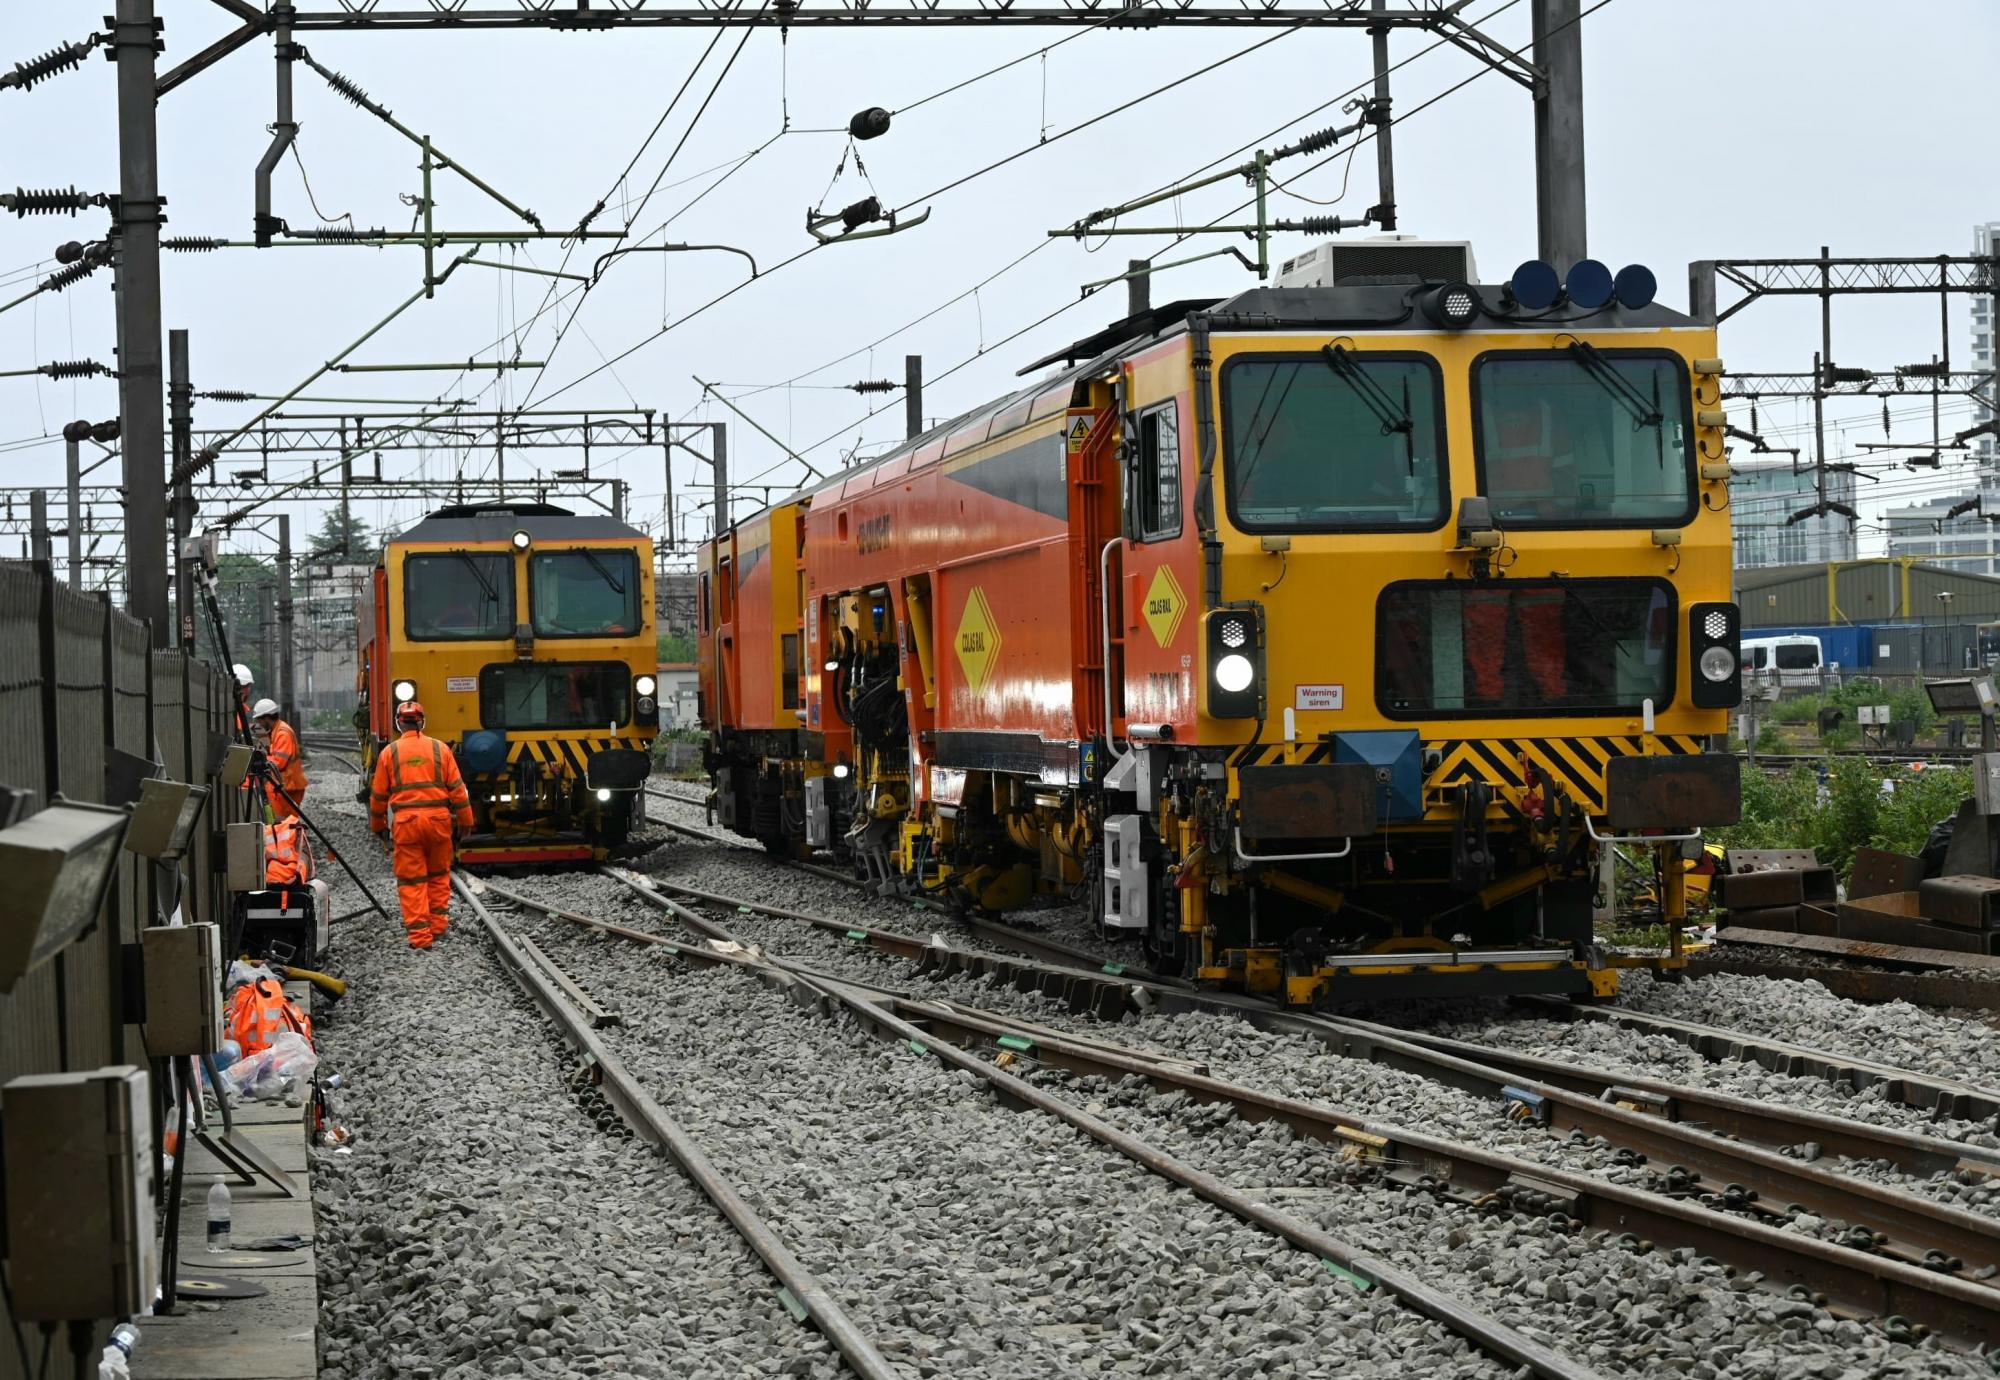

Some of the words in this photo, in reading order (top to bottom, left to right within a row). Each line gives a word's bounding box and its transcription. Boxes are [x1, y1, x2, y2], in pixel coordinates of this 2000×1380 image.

[1150, 599, 1162, 615] COLAS
[1163, 598, 1171, 613] RAIL
[185, 615, 191, 623] G
[962, 632, 975, 653] COLAS
[975, 631, 985, 651] RAIL
[1302, 688, 1337, 698] Warning
[1309, 698, 1330, 706] siren
